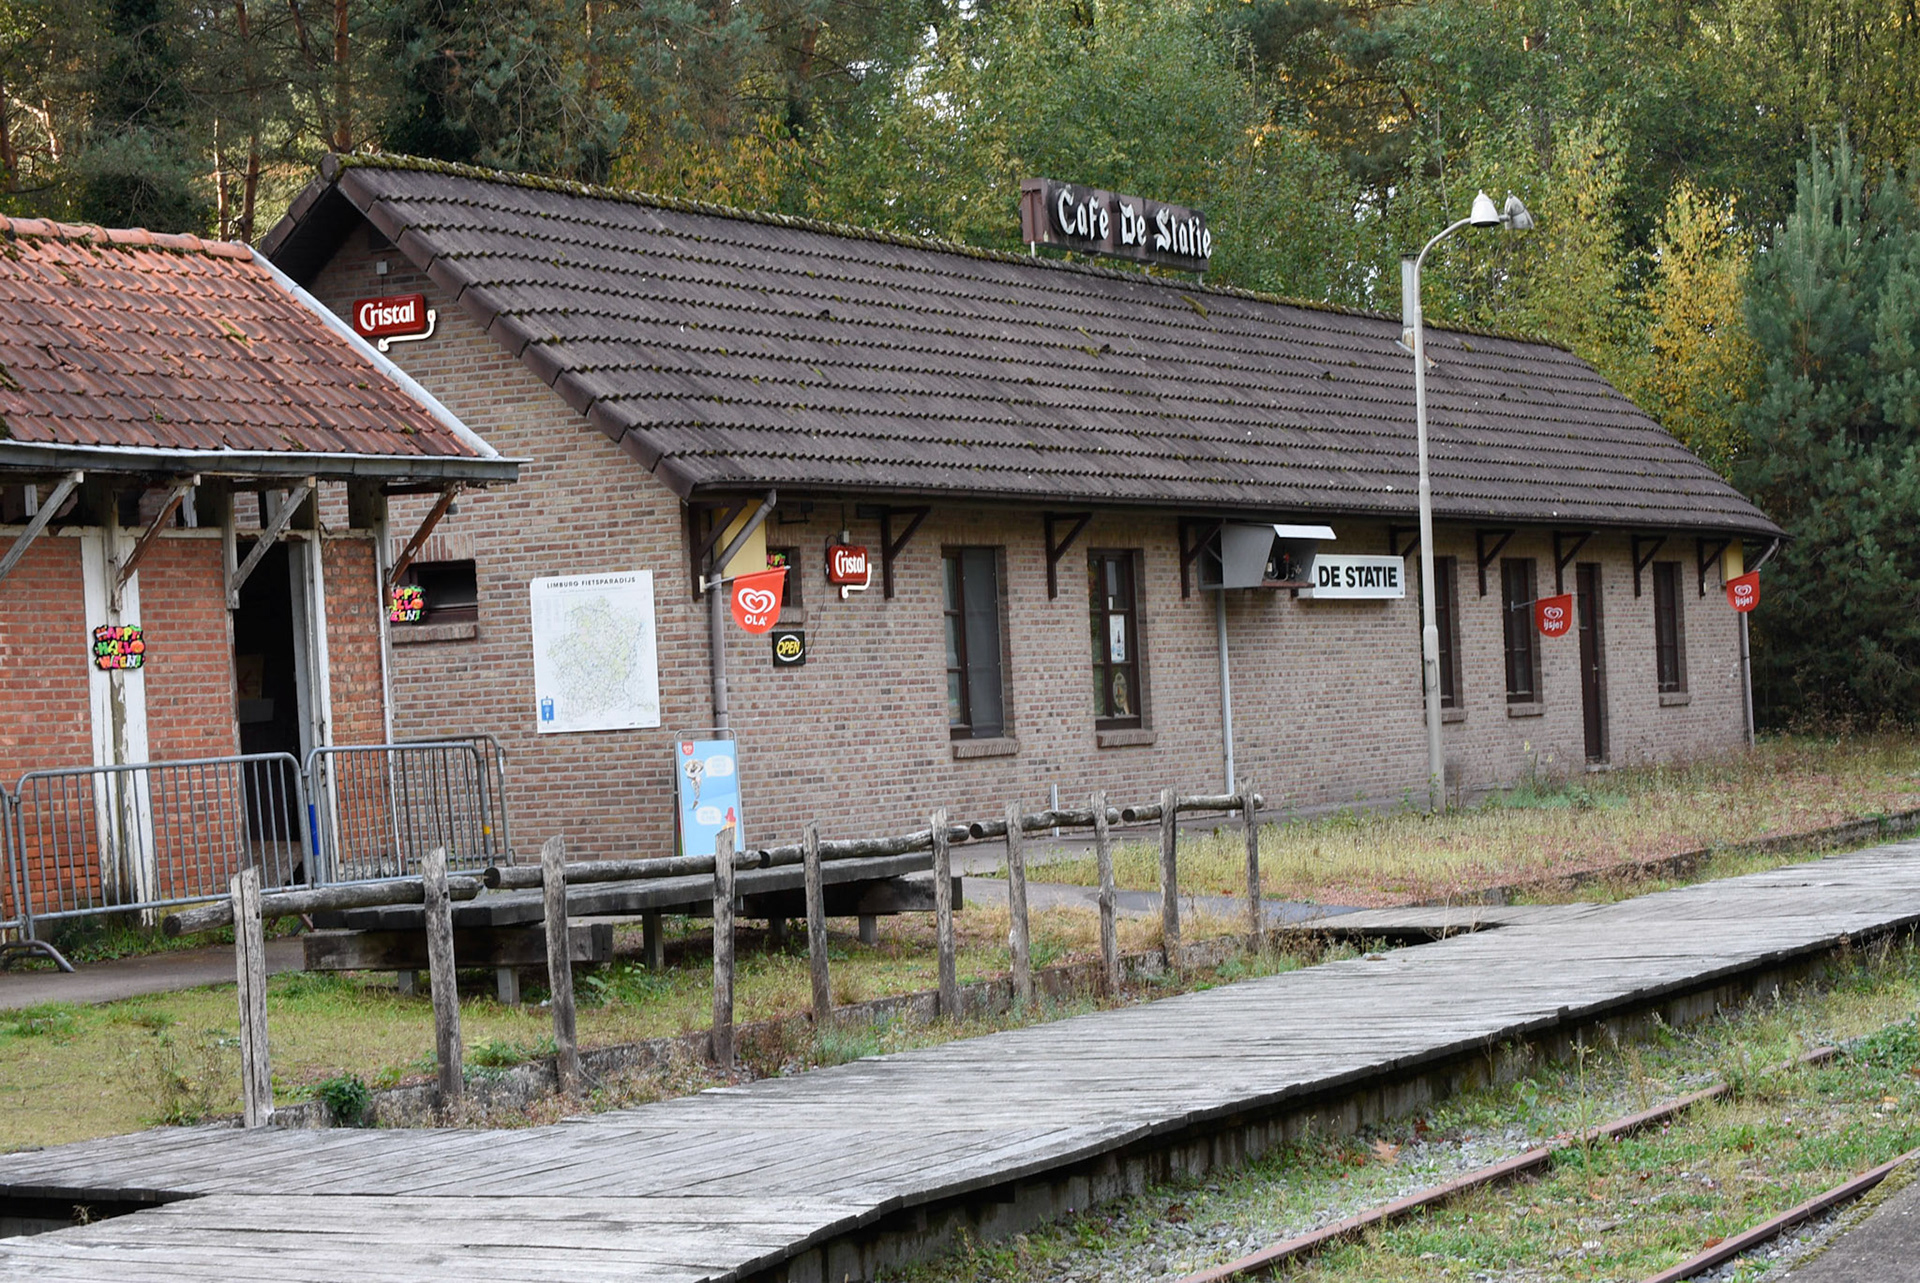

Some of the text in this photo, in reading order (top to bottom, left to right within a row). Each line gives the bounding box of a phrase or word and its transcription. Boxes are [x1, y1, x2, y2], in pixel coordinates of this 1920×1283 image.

[1119, 201, 1147, 246] De
[1153, 208, 1212, 260] Statie
[359, 300, 416, 331] Cristal
[835, 550, 865, 578] Cristal
[546, 577, 636, 589] LIMBURG FIETSPARADIJS
[1318, 566, 1398, 588] DE STATIE
[776, 641, 801, 655] OPEN
